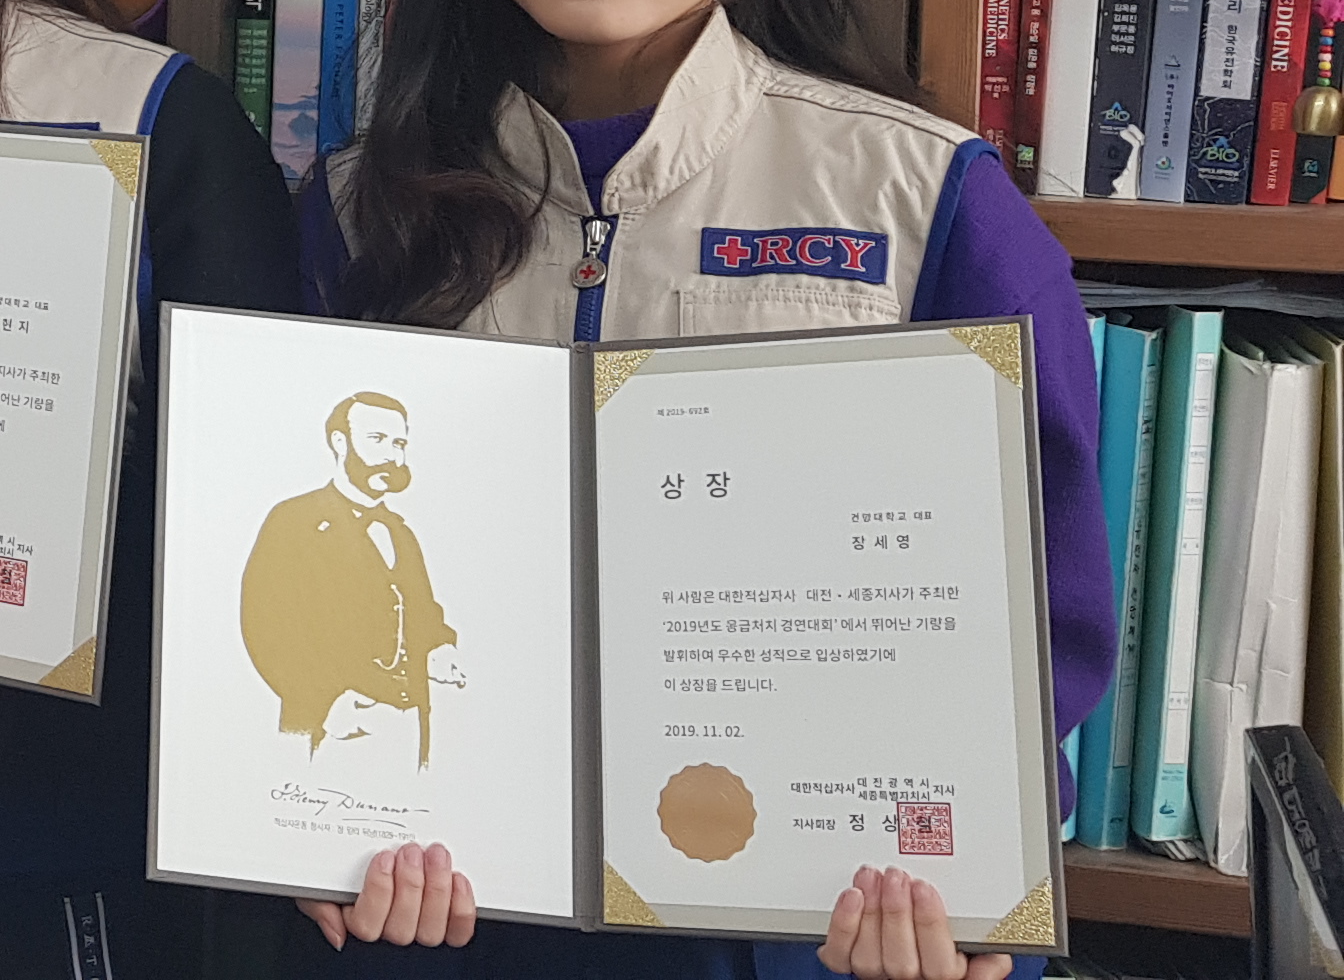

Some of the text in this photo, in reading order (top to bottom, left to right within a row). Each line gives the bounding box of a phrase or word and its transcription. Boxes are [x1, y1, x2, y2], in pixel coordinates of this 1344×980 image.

[752, 234, 875, 272] RCY
[678, 587, 959, 604] 사람은 대한적십자사 대전 세종지사가 주최한
[726, 619, 777, 633] 응급처치
[841, 619, 867, 632] 에서
[872, 618, 911, 631] 뛰어난
[916, 617, 956, 631] 기량을
[664, 649, 896, 663] 발휘하여 우수한 성적으로 입상하였기에
[664, 678, 778, 692] 이 상장을 드립니다.
[665, 725, 744, 738] 2019. 11. 02.
